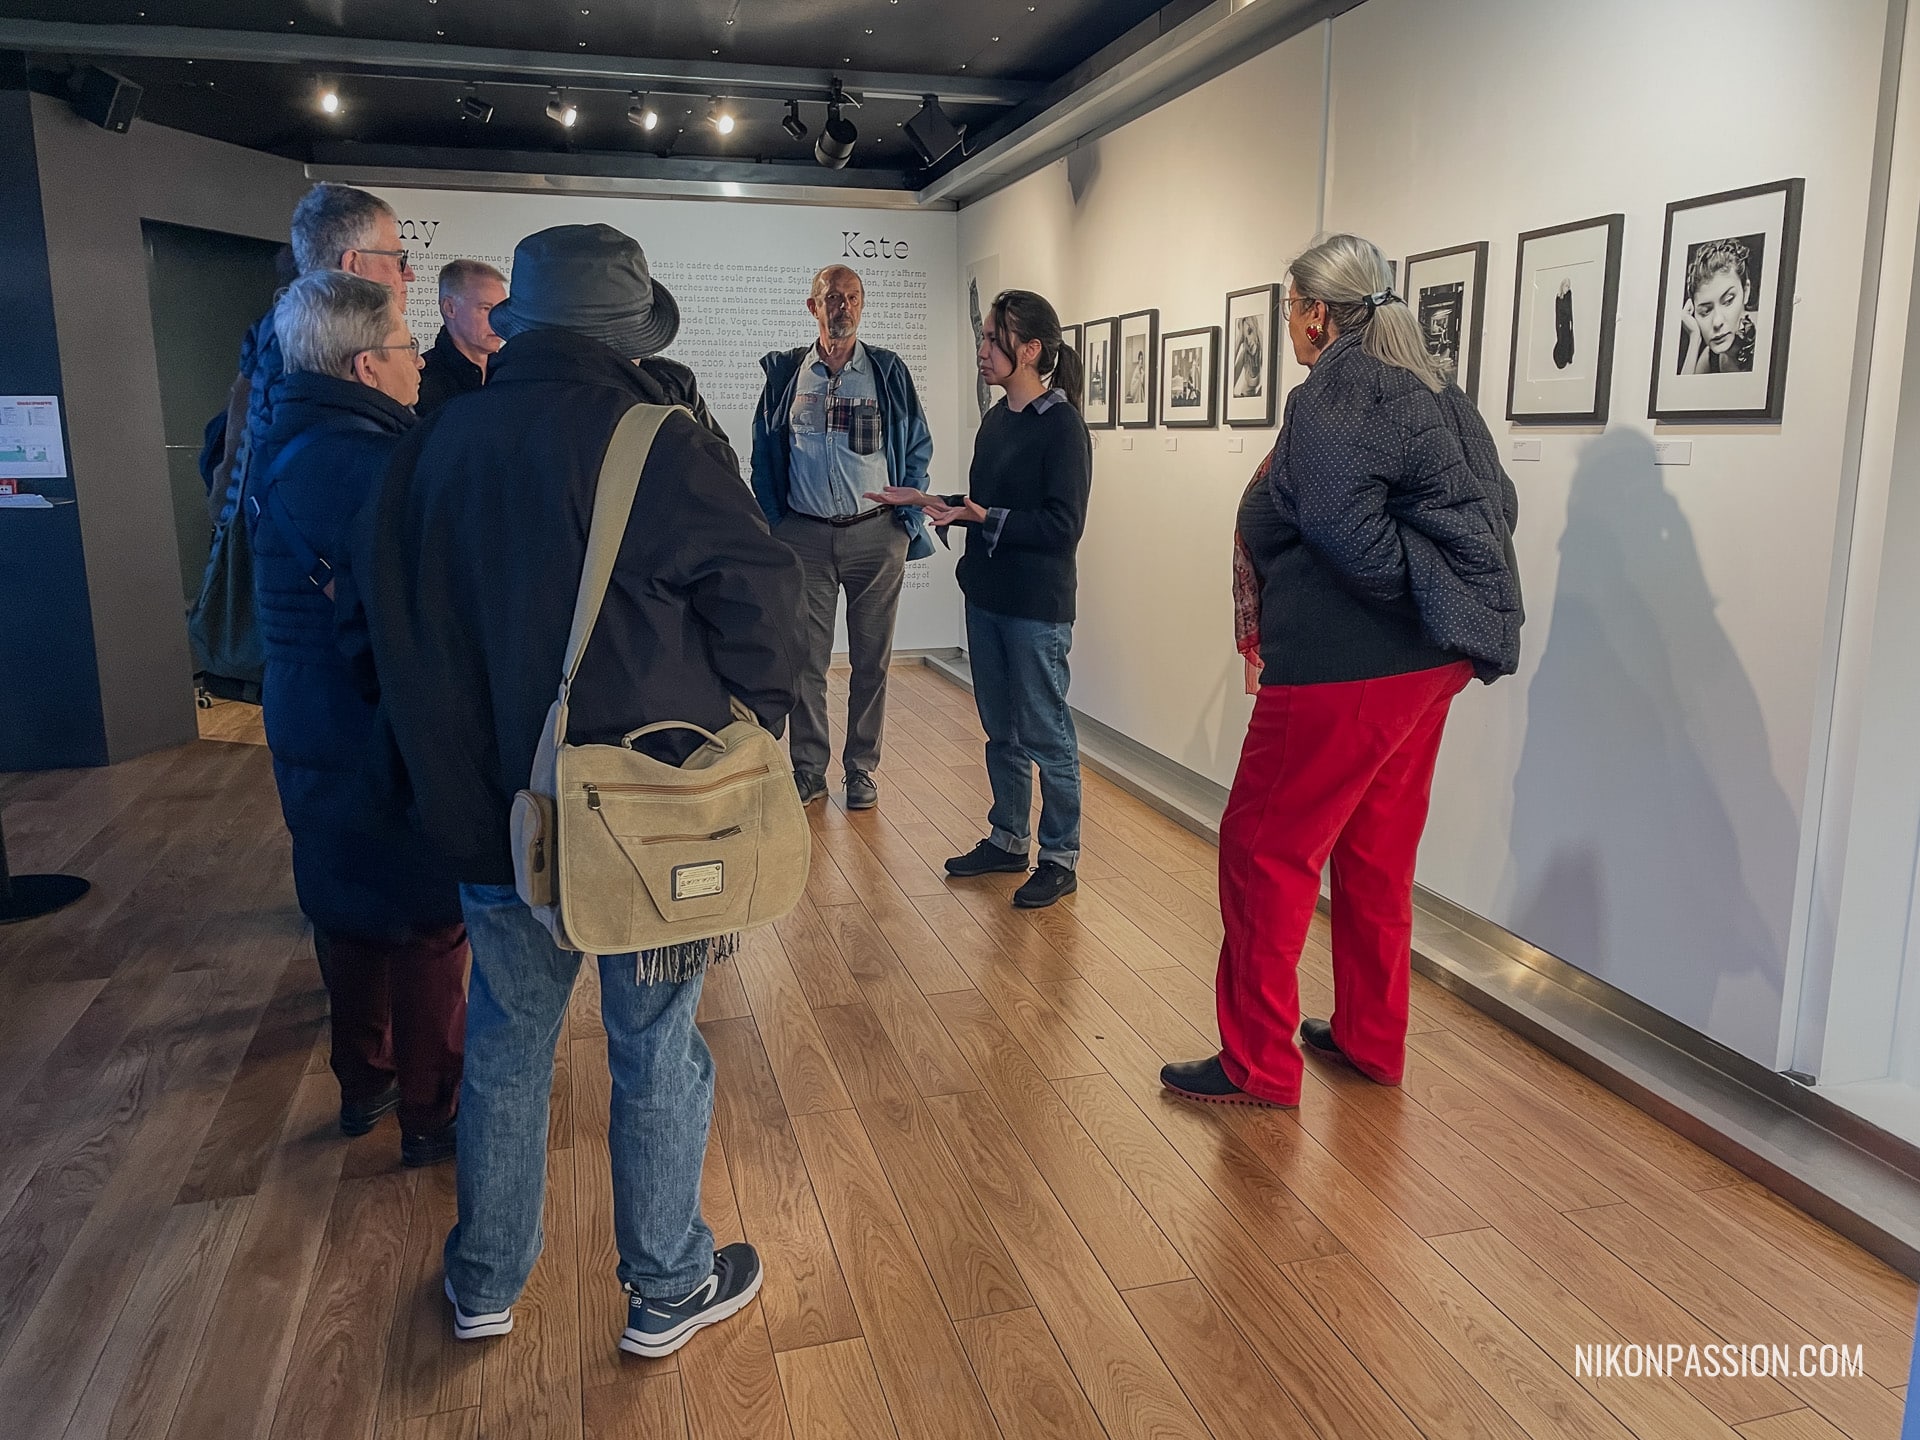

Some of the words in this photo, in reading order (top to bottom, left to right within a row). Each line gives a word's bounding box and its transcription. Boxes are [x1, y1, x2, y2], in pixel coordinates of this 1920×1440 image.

[398, 219, 440, 248] ny
[841, 231, 909, 260] Kate
[727, 264, 778, 272] commandes
[787, 276, 812, 286] Stylis
[761, 318, 817, 328] Cosmopolita
